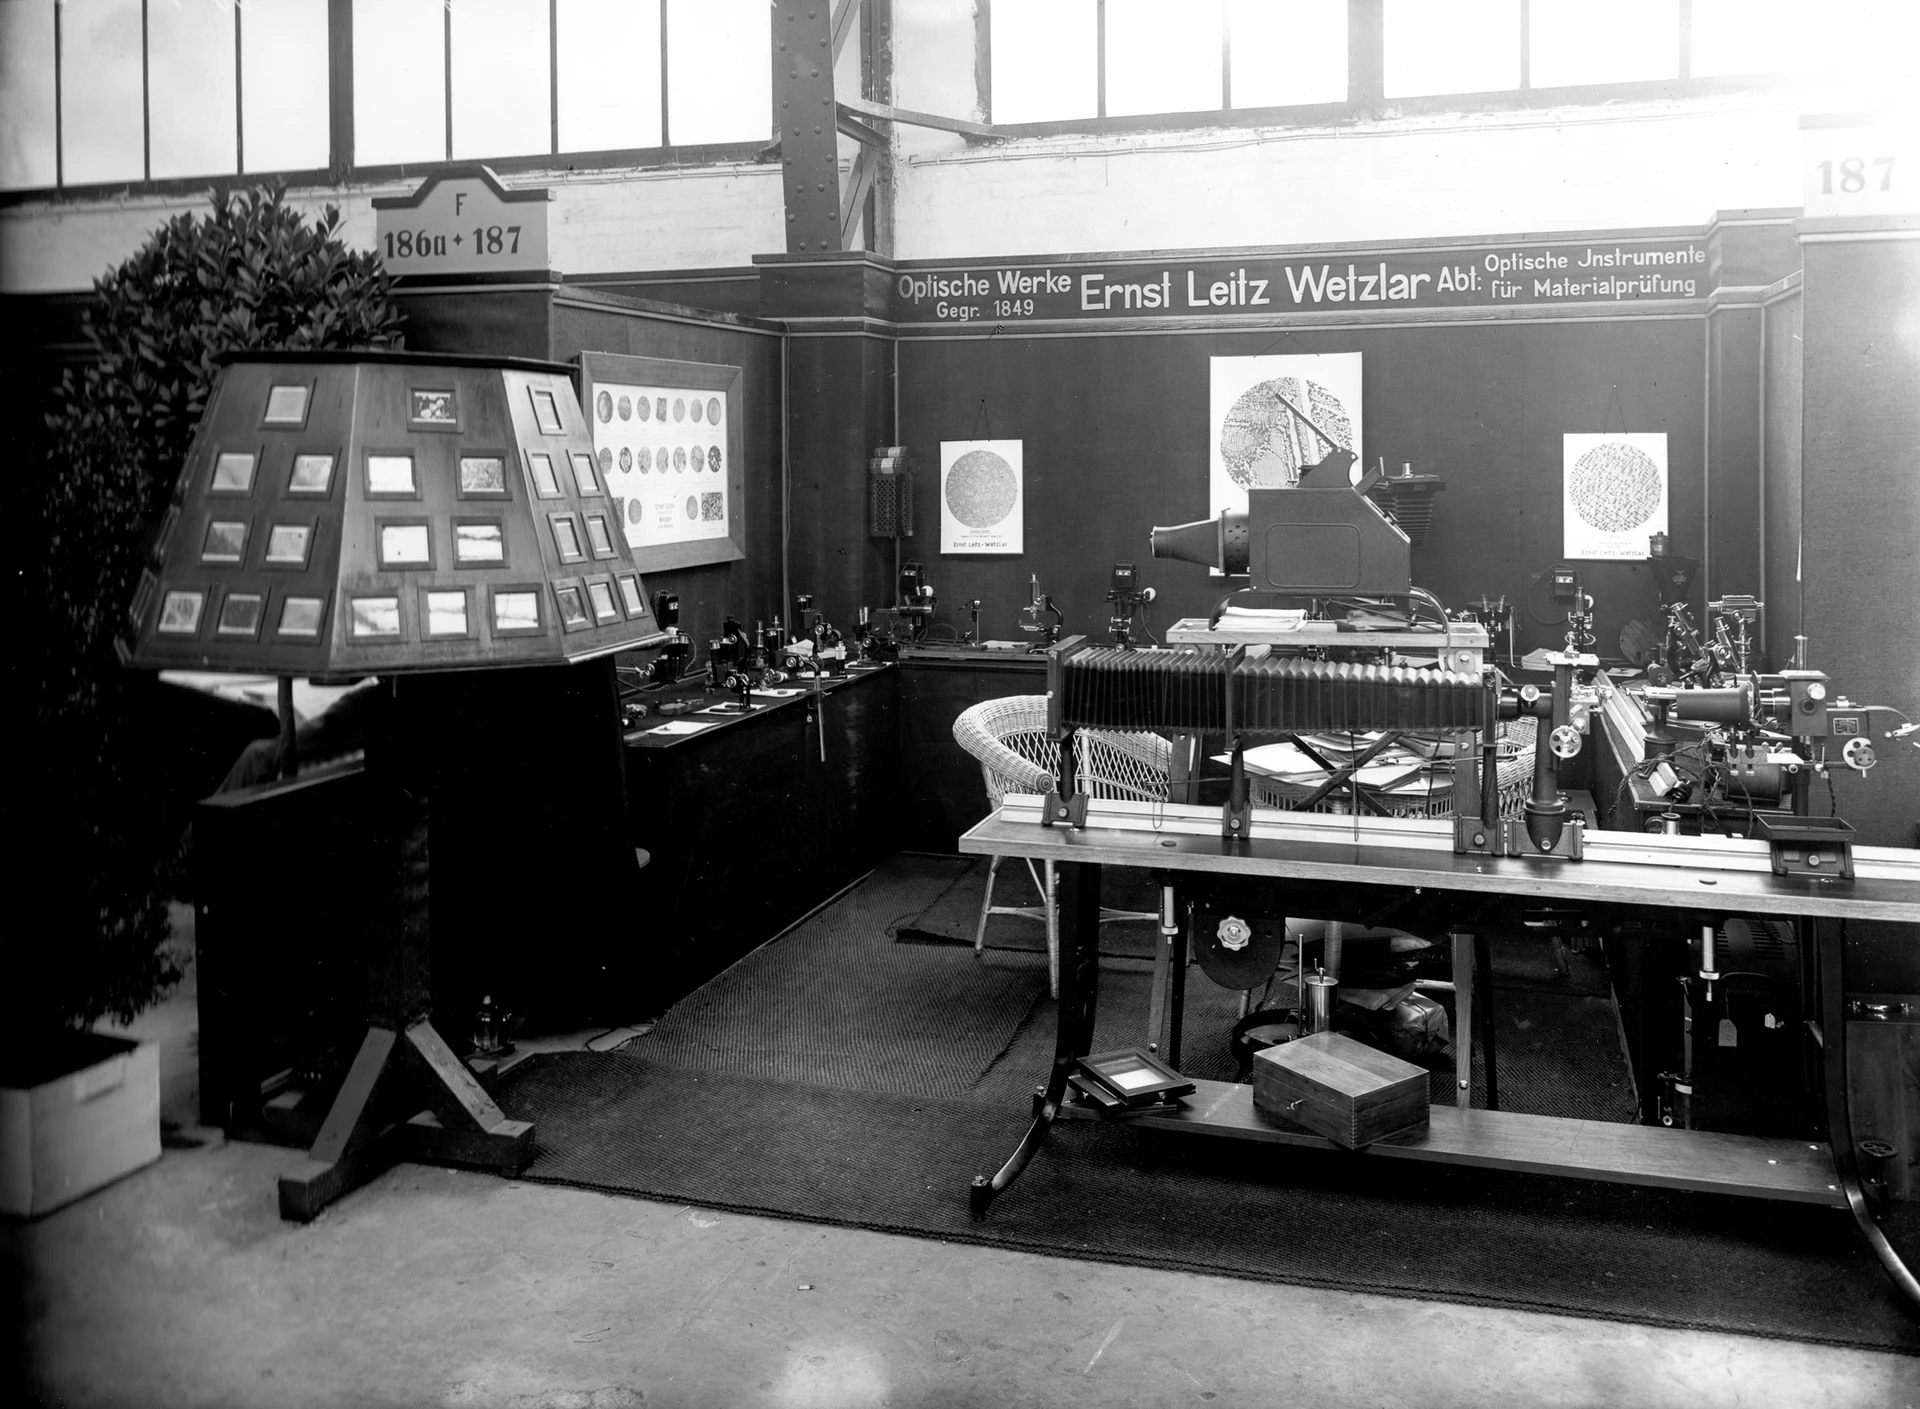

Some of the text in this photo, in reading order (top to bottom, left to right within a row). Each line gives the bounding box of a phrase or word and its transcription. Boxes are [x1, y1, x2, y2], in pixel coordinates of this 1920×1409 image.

[1816, 156, 1897, 195] 187
[455, 193, 467, 216] F
[384, 225, 522, 259] 186a 187
[1484, 251, 1569, 277] Optische
[897, 274, 990, 301] Optische
[996, 269, 1072, 295] Werke
[1080, 271, 1172, 311] Ernst
[1186, 268, 1270, 307] Leitz
[1284, 263, 1432, 304] Wetzlar
[1490, 274, 1697, 300] für Materialprüfung
[936, 299, 1035, 322] Gegr. 1849
